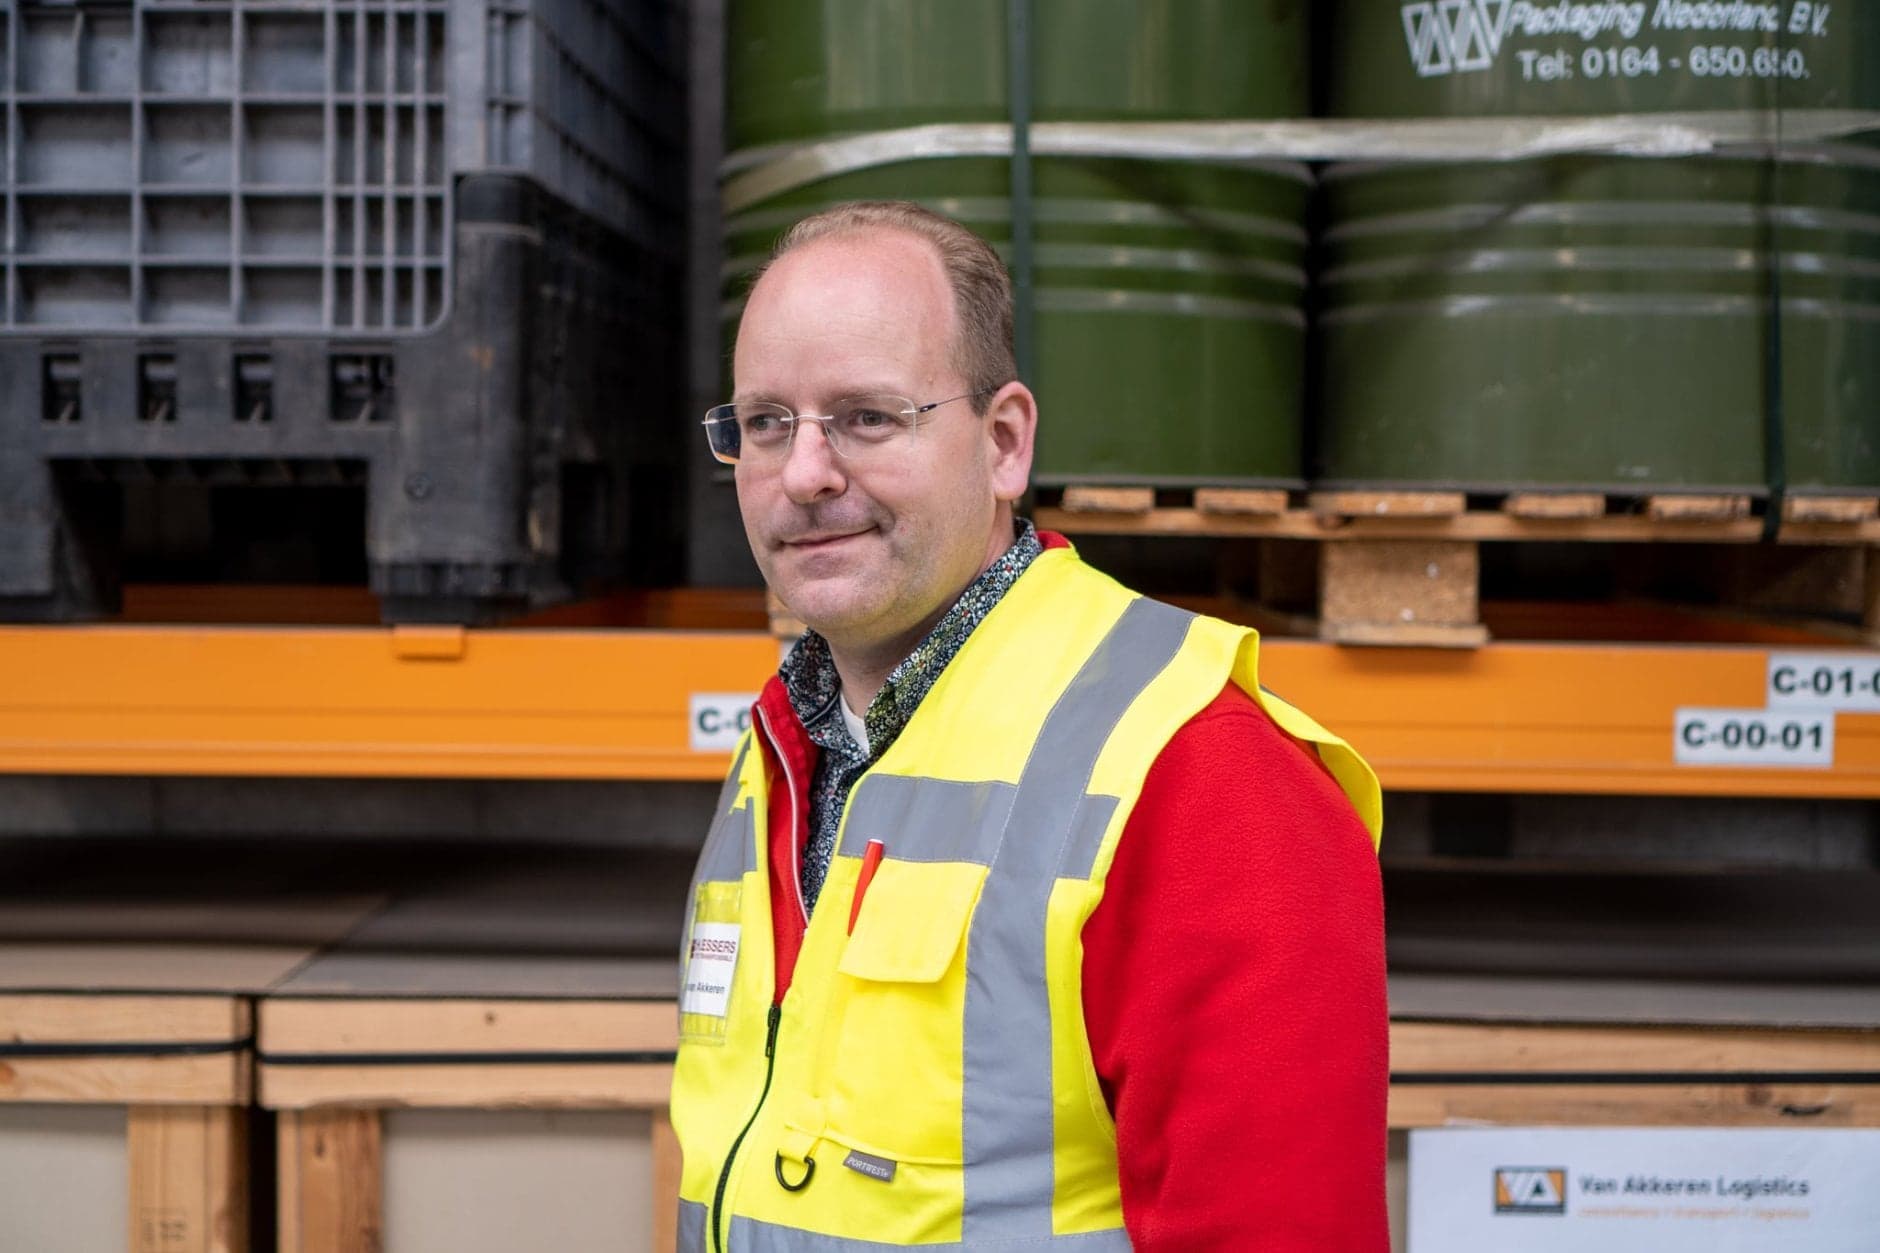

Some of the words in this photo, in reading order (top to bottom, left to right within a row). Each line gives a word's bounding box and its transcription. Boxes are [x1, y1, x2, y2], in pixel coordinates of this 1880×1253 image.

[1507, 0, 1645, 40] Packaging
[1581, 46, 1661, 79] 0164
[1682, 720, 1823, 749] C-00-01
[1579, 1175, 1617, 1195] Van
[1623, 1174, 1712, 1196] Akkeren
[1717, 1174, 1809, 1201] Logistics
